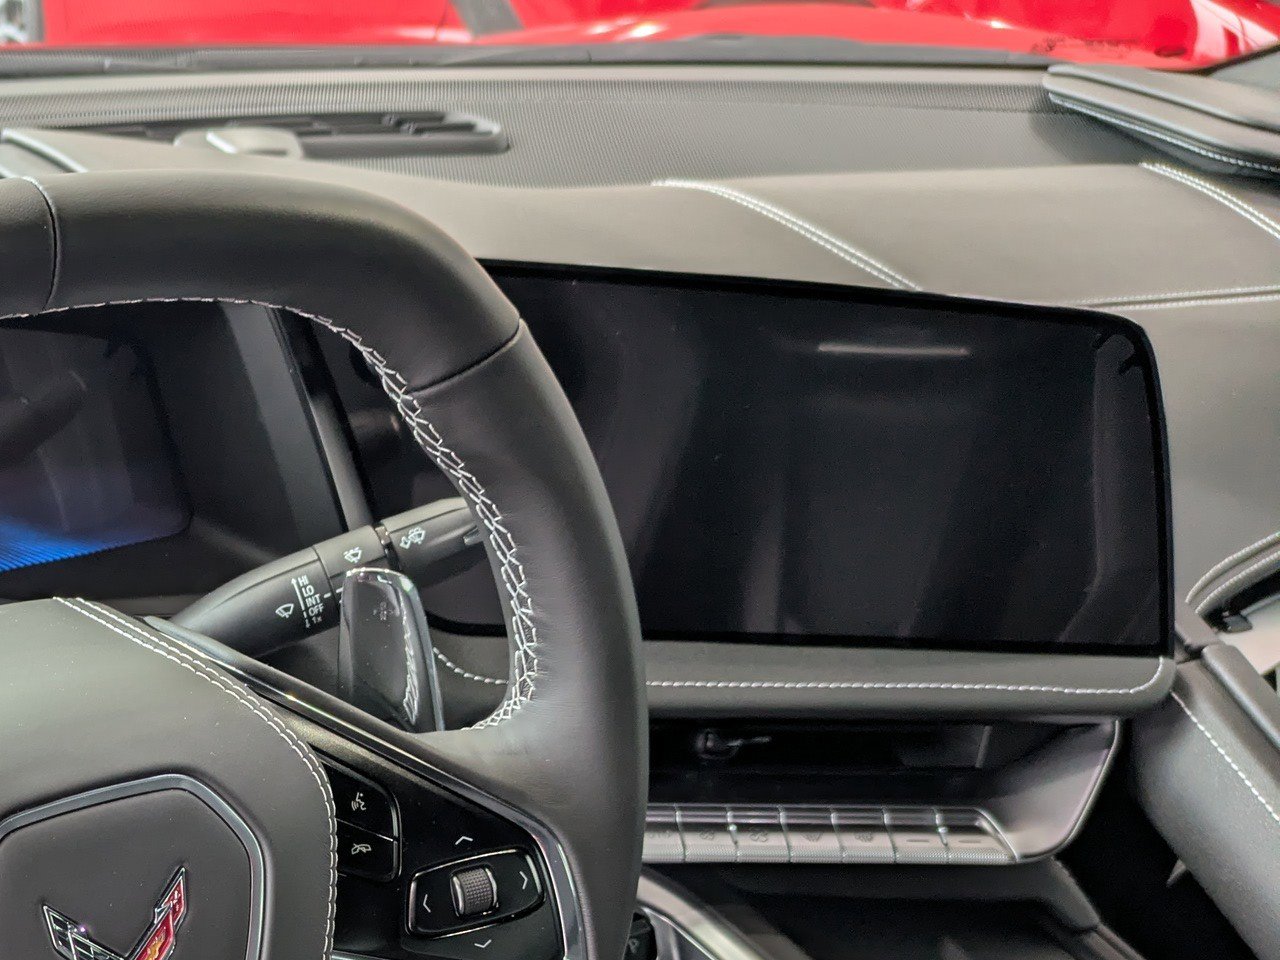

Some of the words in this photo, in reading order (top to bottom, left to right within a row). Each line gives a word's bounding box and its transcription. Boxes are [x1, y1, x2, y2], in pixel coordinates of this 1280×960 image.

[297, 574, 309, 587] HI
[301, 585, 315, 597] LO
[305, 593, 321, 606] INT
[308, 604, 324, 617] OFF
